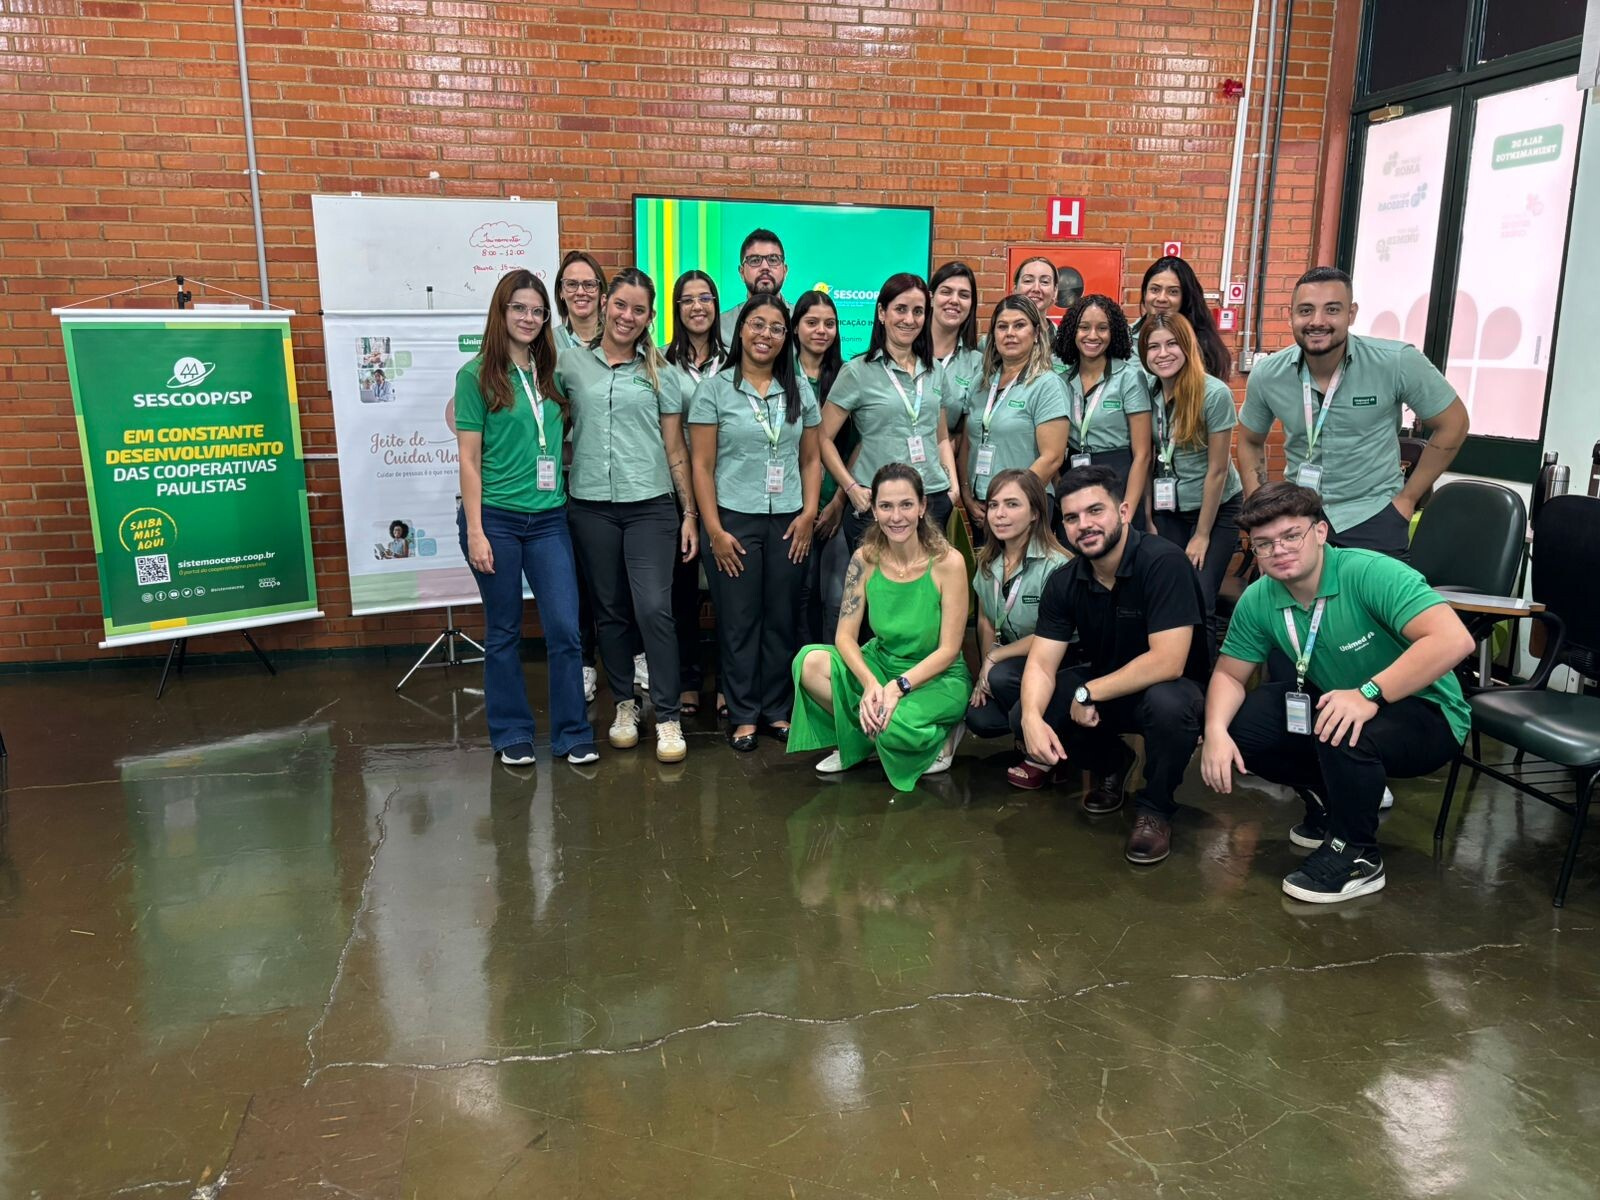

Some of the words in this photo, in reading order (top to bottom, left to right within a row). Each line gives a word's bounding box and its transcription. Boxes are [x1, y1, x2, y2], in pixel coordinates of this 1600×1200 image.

[1052, 200, 1080, 236] H
[132, 391, 254, 408] SESCOOP/SP
[123, 429, 155, 445] EM
[157, 425, 264, 443] CONSTANTE
[370, 433, 405, 454] Jeito
[410, 431, 426, 446] de
[106, 441, 284, 465] DESENVOLVIMENTO
[384, 448, 434, 465] Cuidar
[436, 448, 460, 464] Un
[113, 466, 150, 482] DAS
[153, 459, 278, 479] COOPERATIVAS
[156, 478, 247, 497] PAULISTAS
[130, 517, 163, 531] SAIBA
[133, 528, 161, 541] MAIS
[137, 538, 164, 551] AQUI
[177, 551, 276, 569] sistemaocesp.coop.br
[1339, 635, 1368, 652] Unimed
